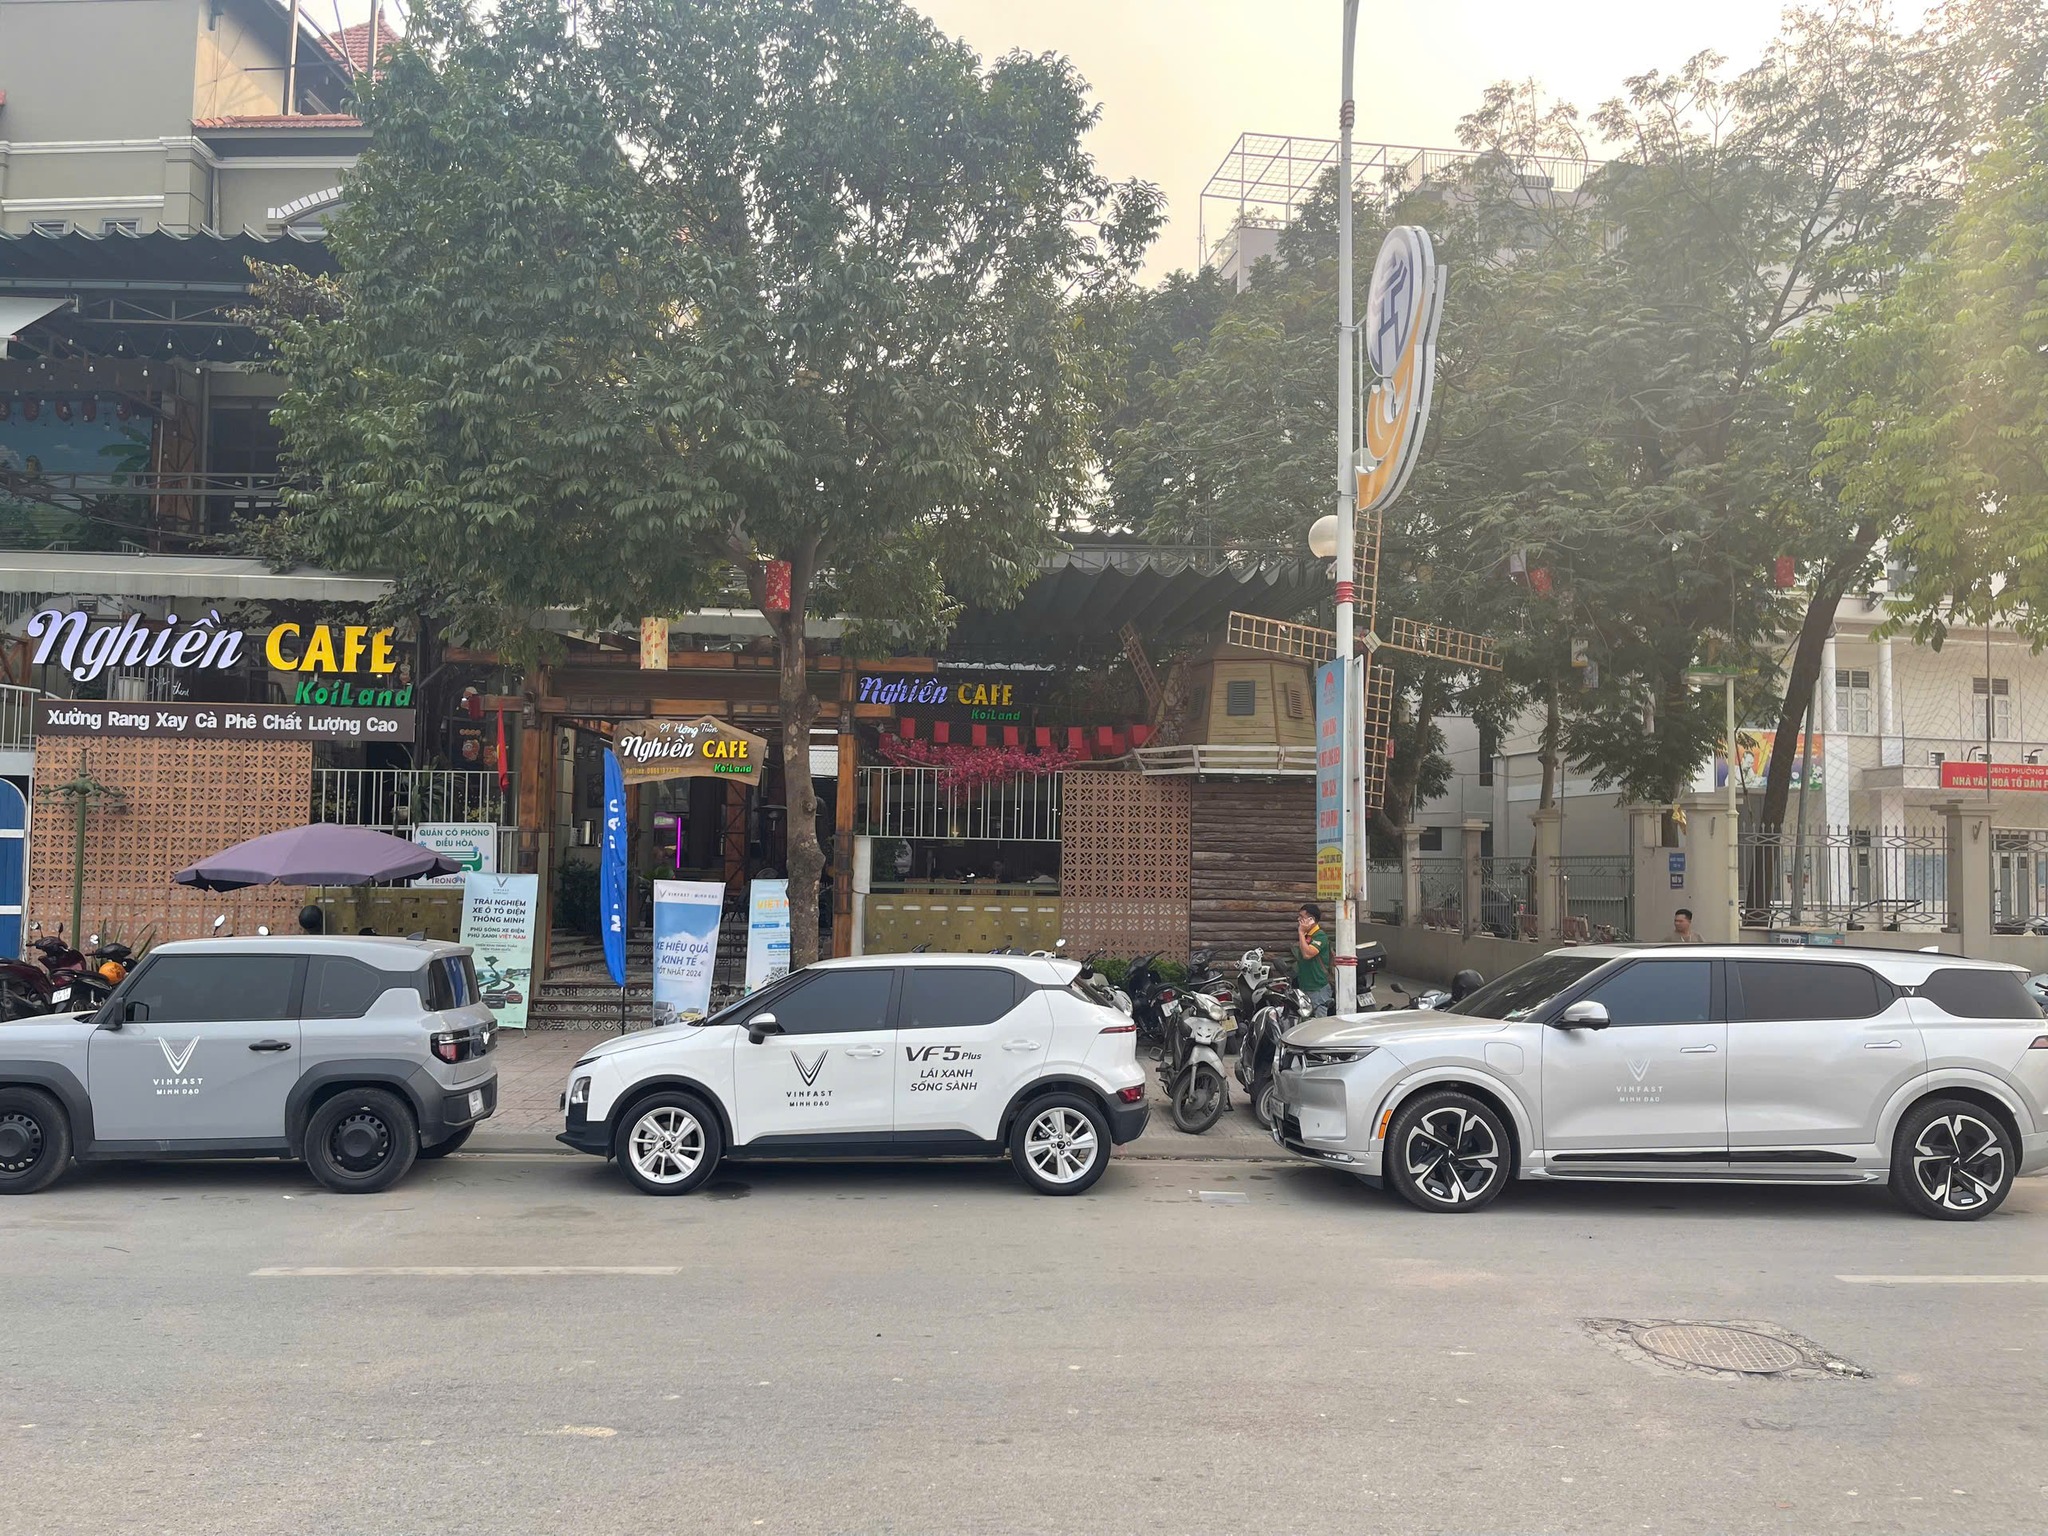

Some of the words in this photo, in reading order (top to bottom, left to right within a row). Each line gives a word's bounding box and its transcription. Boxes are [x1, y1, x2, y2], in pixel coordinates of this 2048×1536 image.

[265, 622, 398, 674] CAFE
[294, 679, 412, 707] KoiLand
[957, 682, 1014, 706] CAFE
[47, 709, 102, 730] Xưởng
[108, 711, 150, 730] Rang
[155, 712, 188, 731] Xay
[195, 710, 217, 730] Cà
[225, 712, 257, 731] Phê
[263, 712, 303, 731] Chất
[308, 715, 361, 736] Lượng
[366, 717, 398, 733] Cao
[702, 740, 748, 759] CAFE
[1952, 775, 1972, 786] NHÀ
[460, 829, 490, 837] PHÒNG
[473, 915, 502, 923] THÔNG
[665, 940, 687, 954] HIỆU
[689, 942, 709, 954] QUẢ
[661, 955, 684, 965] KINH
[686, 969, 702, 977] 2024
[961, 1052, 982, 1061] Plus
[920, 1068, 938, 1078] LÁI
[941, 1069, 973, 1078] XANH
[152, 1077, 203, 1085] VINFAST
[910, 1079, 943, 1092] SỐNG
[945, 1081, 978, 1091] SÀNH
[786, 1090, 832, 1098] VINFAST
[1616, 1085, 1664, 1093] VINFAST
